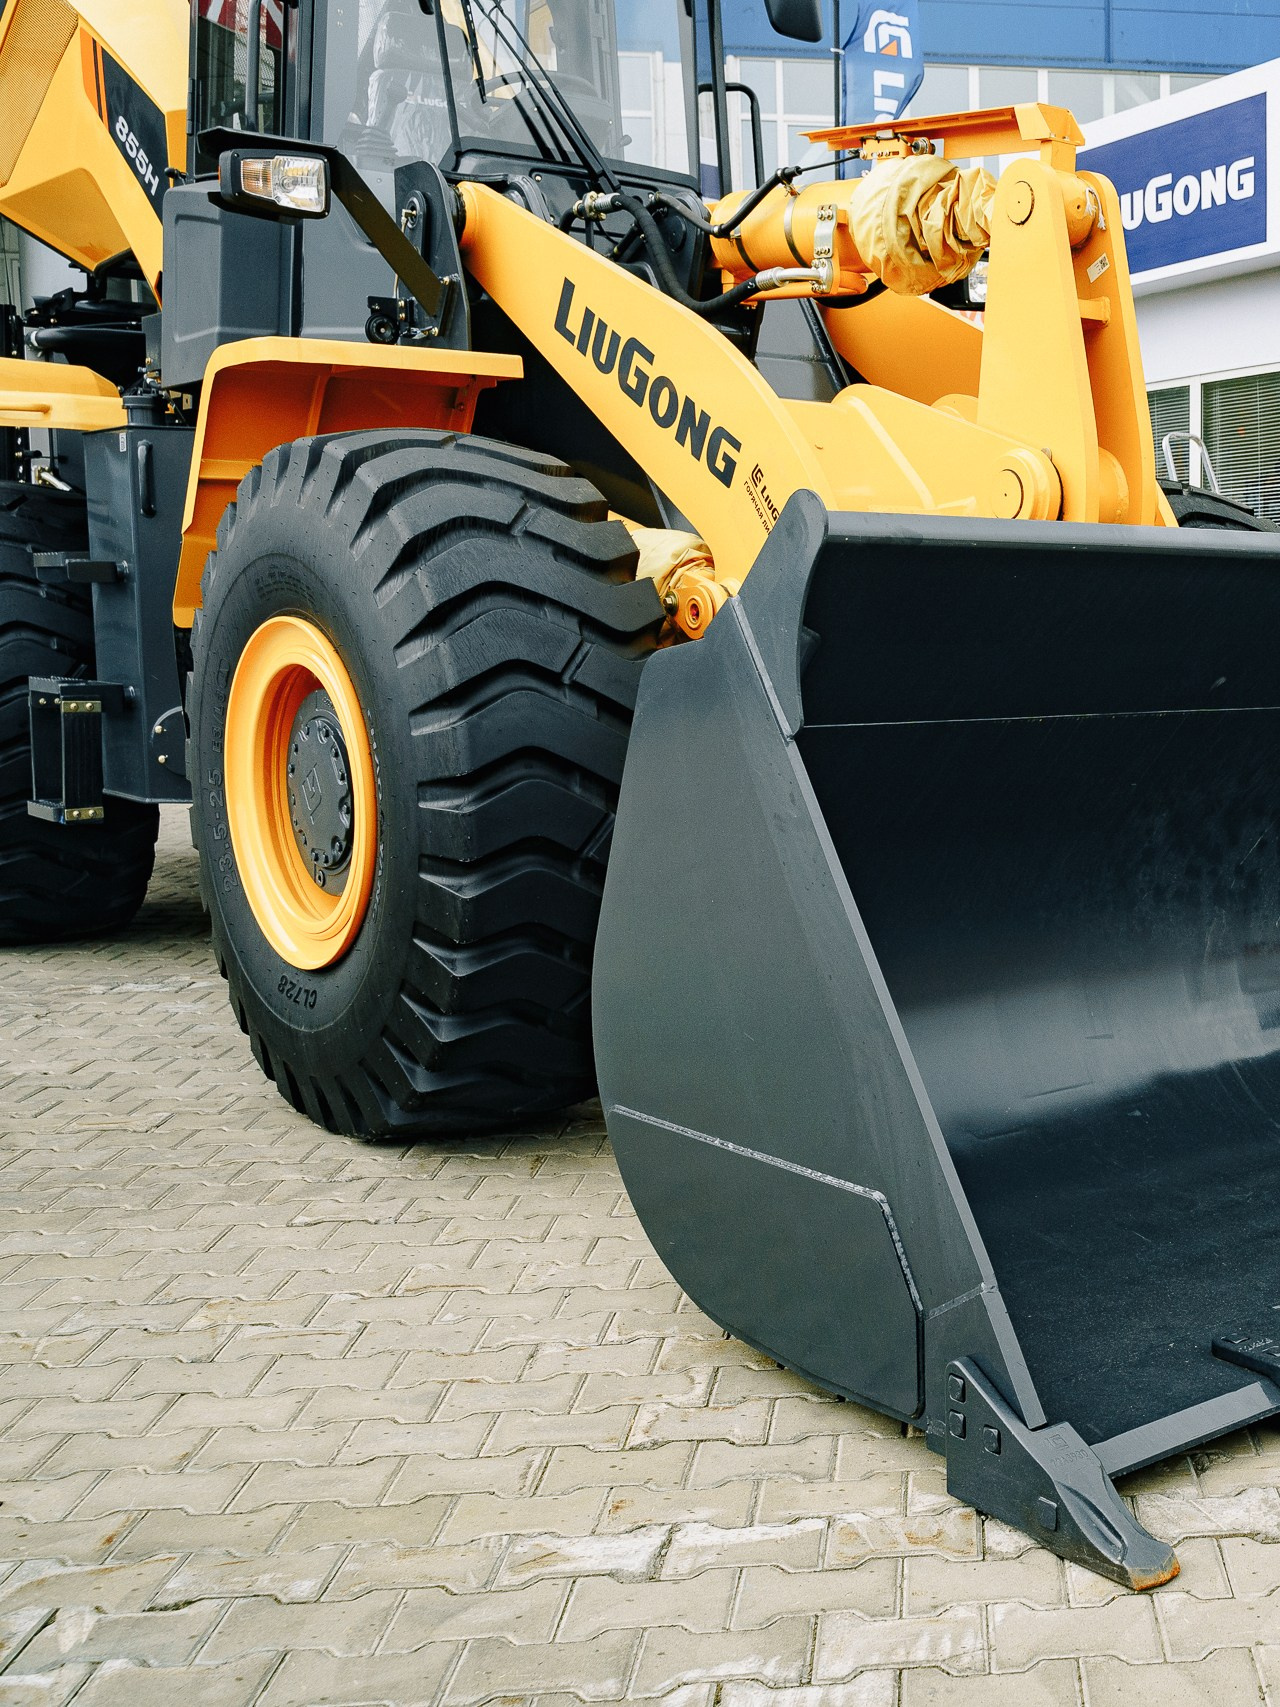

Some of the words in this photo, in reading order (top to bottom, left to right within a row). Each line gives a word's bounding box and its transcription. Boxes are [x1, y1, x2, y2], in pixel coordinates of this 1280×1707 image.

[115, 115, 160, 196] 855H
[743, 480, 764, 519] ГОРЯЧАЯ
[208, 768, 239, 894] 23.5-25
[277, 974, 318, 1010] CL728
